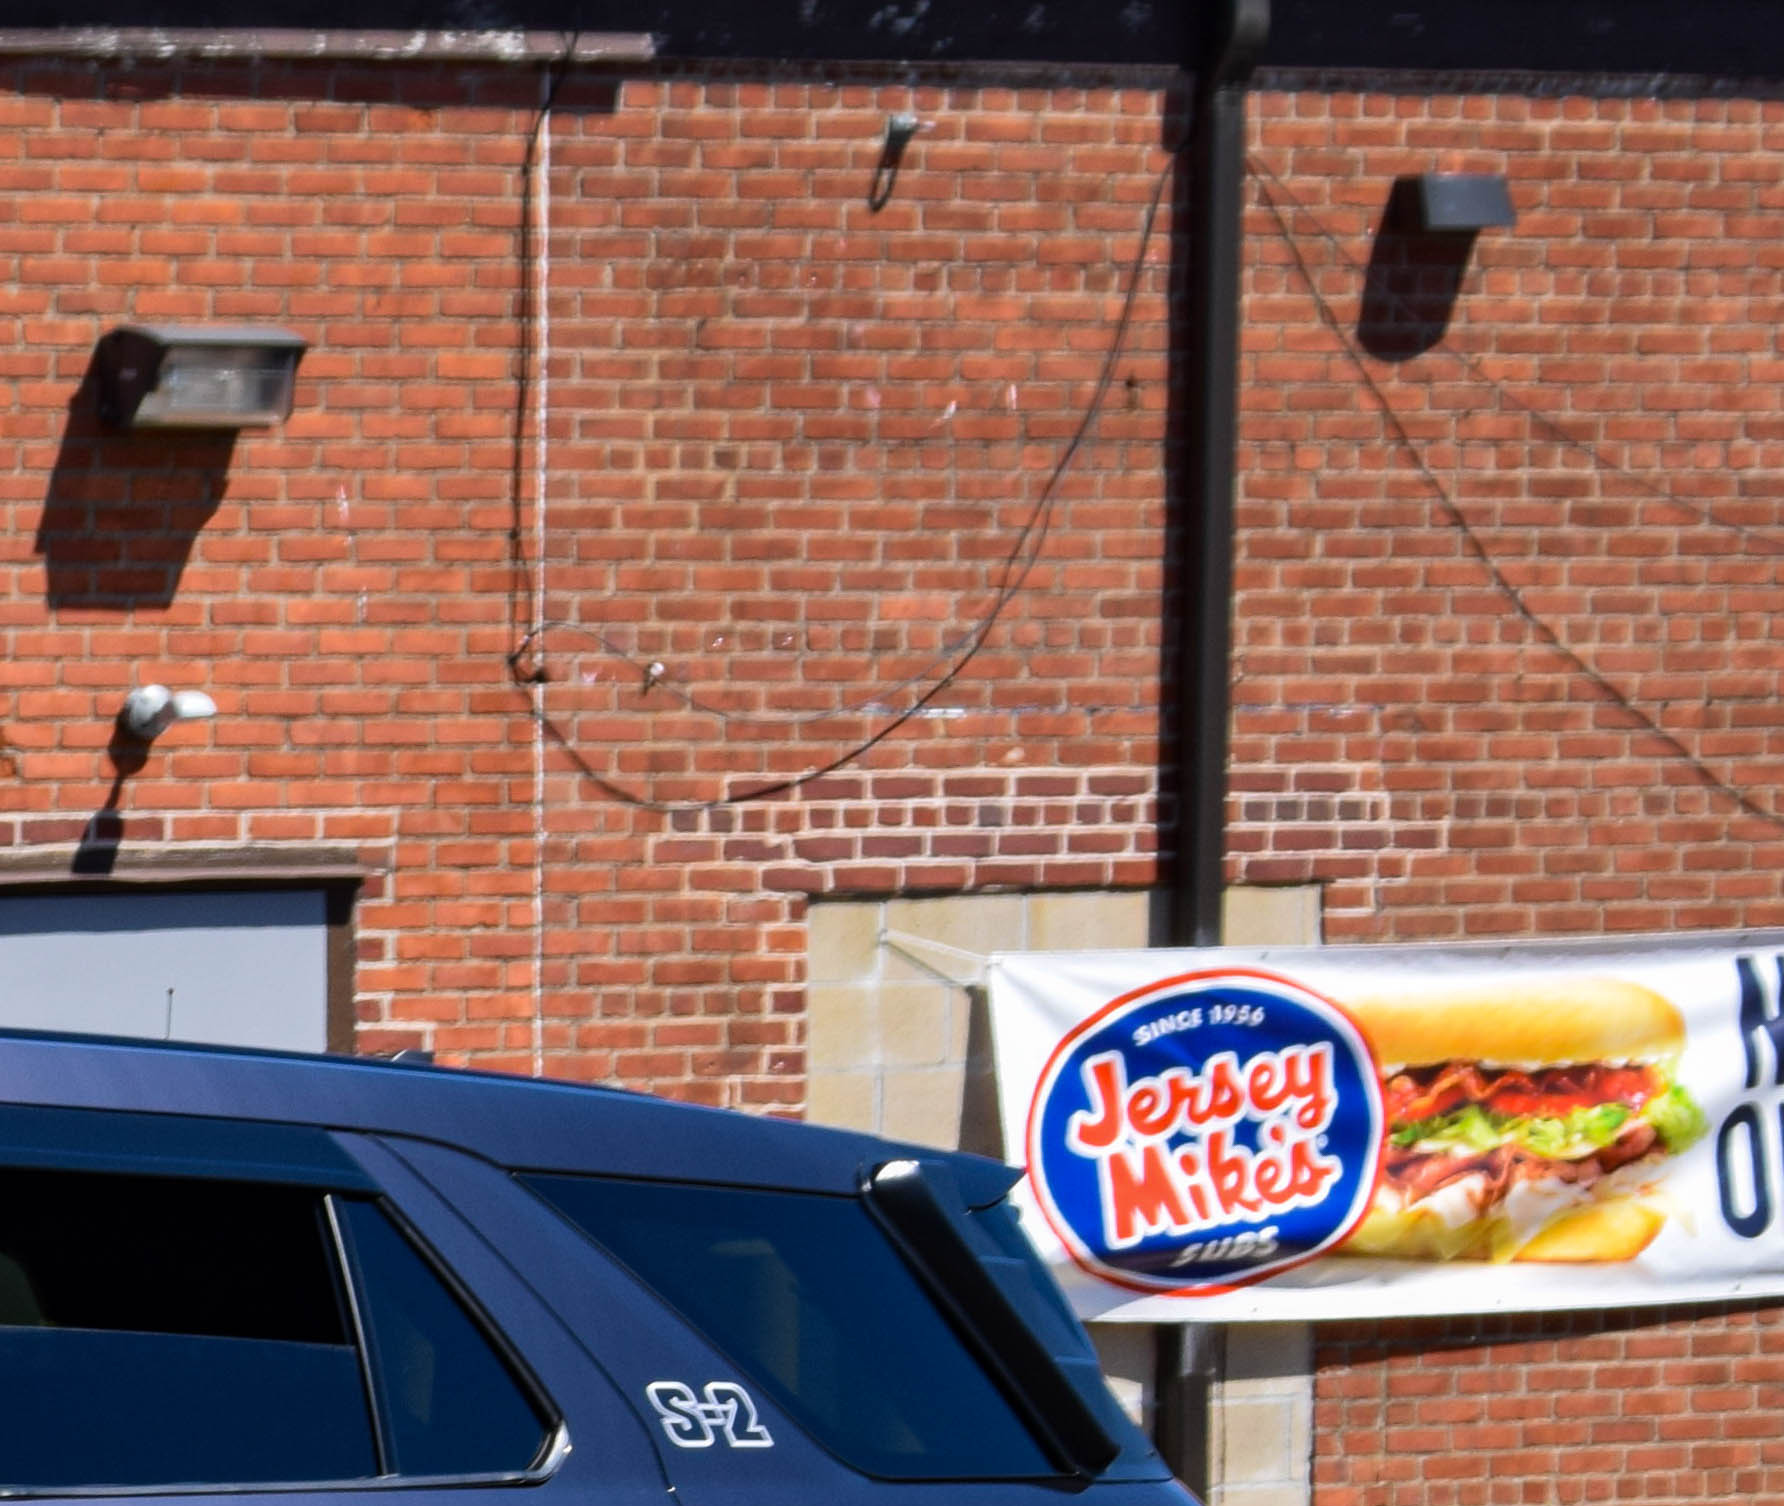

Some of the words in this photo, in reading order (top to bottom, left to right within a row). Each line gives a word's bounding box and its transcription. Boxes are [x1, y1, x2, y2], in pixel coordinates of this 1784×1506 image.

[1133, 1007, 1203, 1045] SINCE
[1208, 1004, 1265, 1026] 1956
[1070, 1044, 1336, 1153] Jersey
[1102, 1124, 1340, 1246] Mike's
[1716, 1102, 1784, 1240] O
[1167, 1225, 1280, 1268] SUBS
[646, 1381, 774, 1447] S-2
